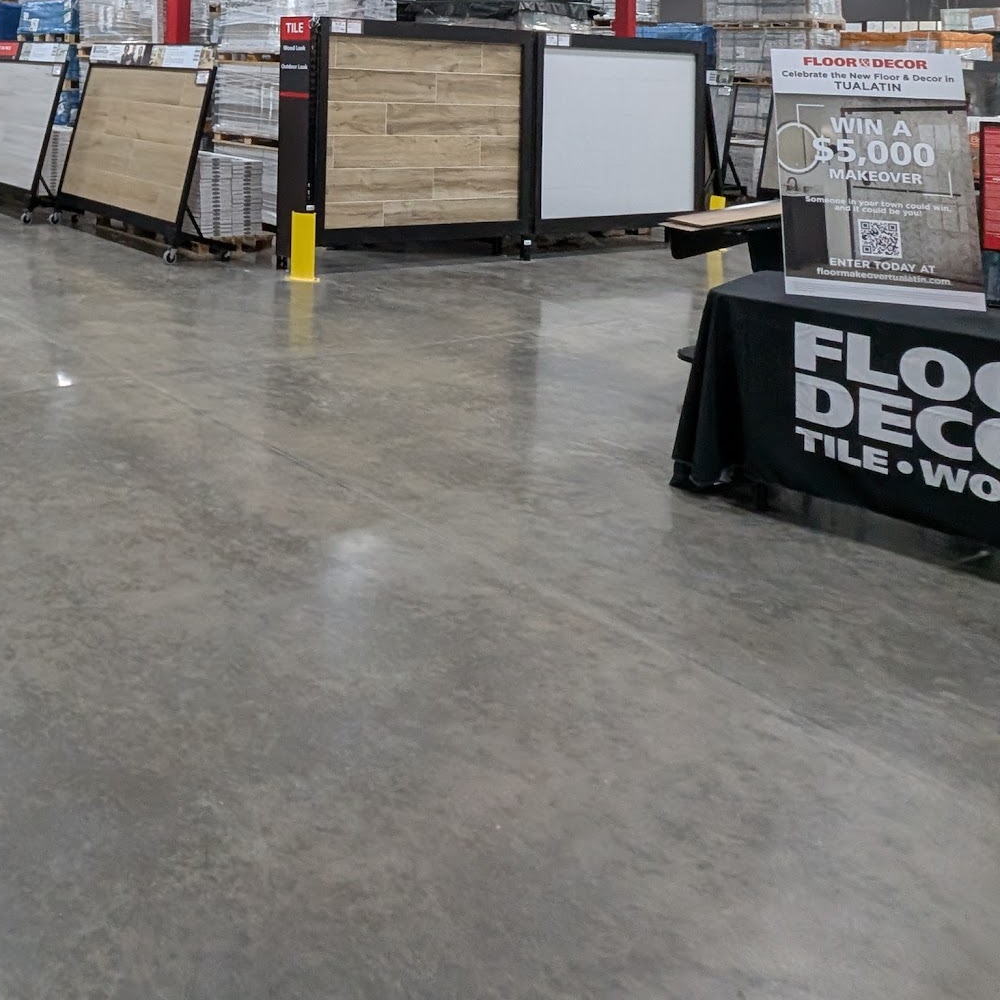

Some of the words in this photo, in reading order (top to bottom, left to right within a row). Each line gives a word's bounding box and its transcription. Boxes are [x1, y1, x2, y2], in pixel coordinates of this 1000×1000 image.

[285, 22, 304, 34] TILE
[803, 56, 857, 67] FLOOR
[872, 58, 928, 70] DECOR
[782, 70, 828, 79] Celebrate
[831, 71, 847, 79] the
[850, 72, 871, 80] New
[874, 73, 900, 81] Floor
[834, 81, 902, 92] TUALATIN
[830, 116, 883, 136] WIN
[892, 120, 912, 137] A
[812, 135, 935, 168] $5,000
[829, 168, 923, 185] MAKEOVER
[805, 195, 846, 205] Someone
[858, 200, 878, 208] your
[881, 201, 903, 209] town
[905, 202, 931, 211] could
[834, 204, 851, 212] and
[861, 206, 887, 214] could
[888, 207, 900, 215] be
[829, 257, 870, 269] ENTER
[873, 260, 916, 272] TODAY
[920, 264, 936, 273] AT
[795, 425, 889, 475] TILE
